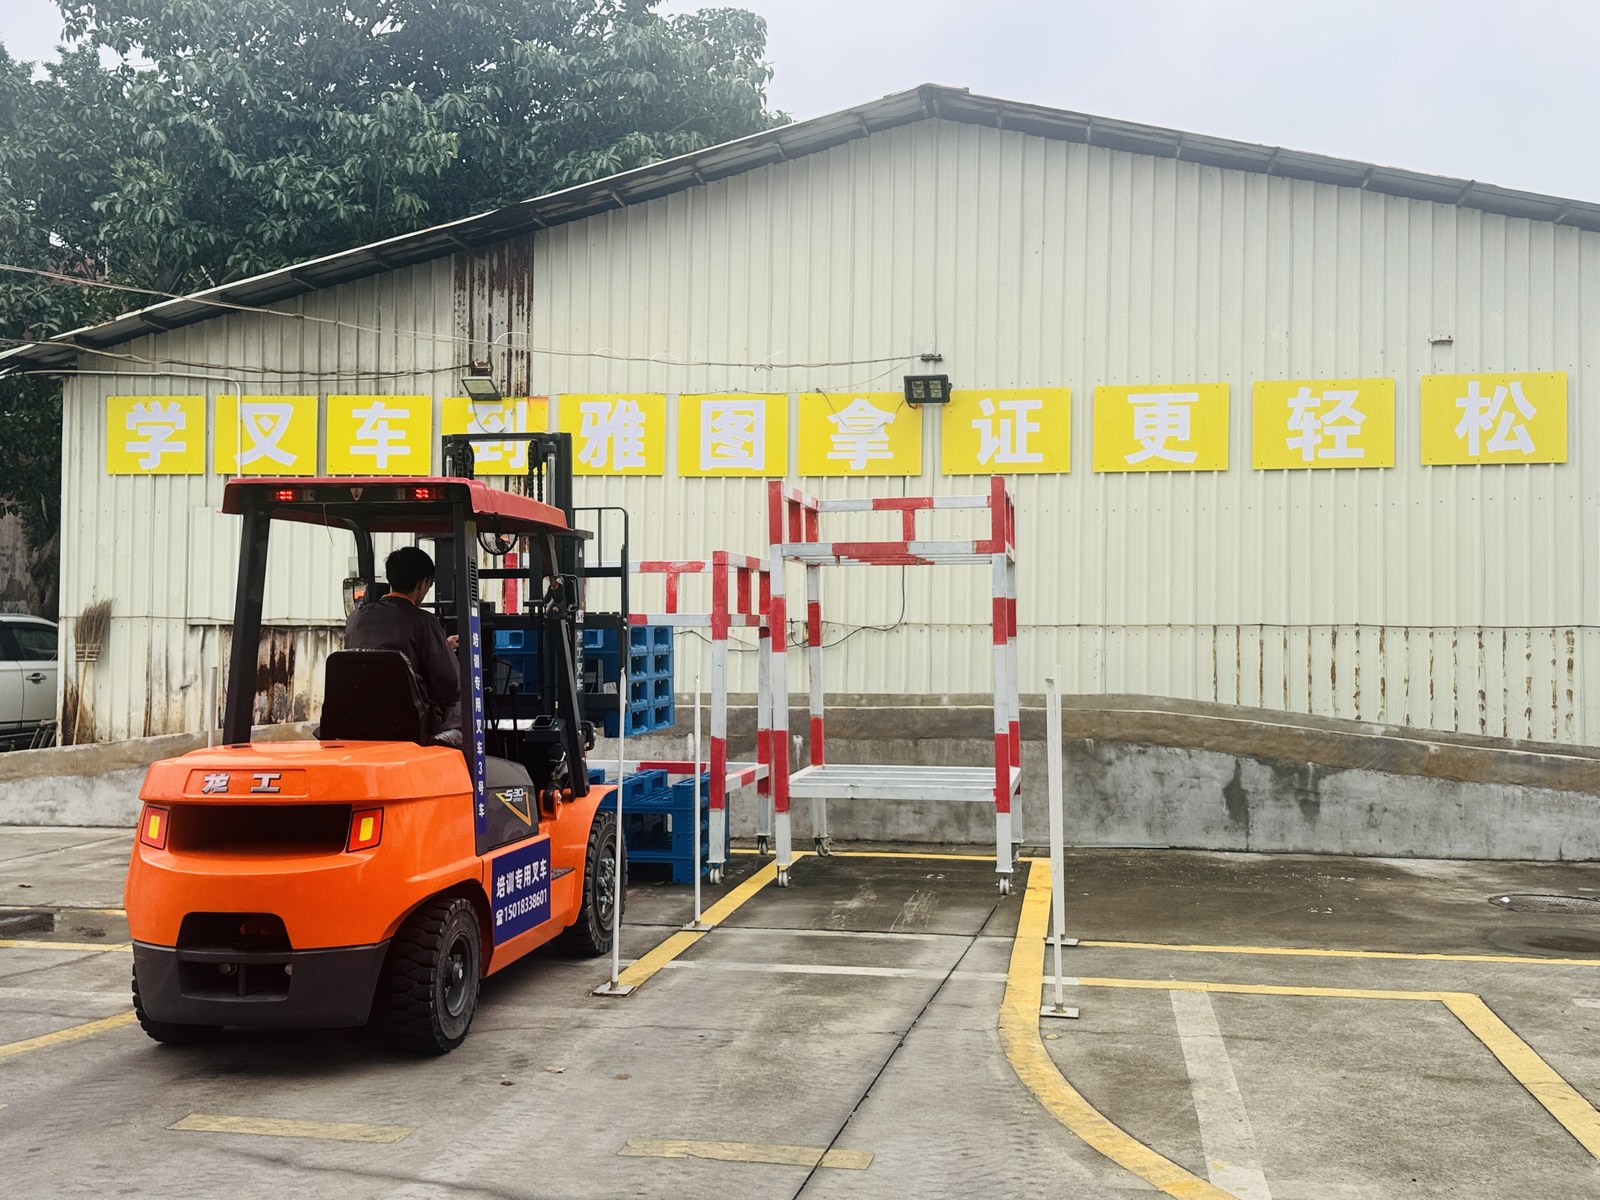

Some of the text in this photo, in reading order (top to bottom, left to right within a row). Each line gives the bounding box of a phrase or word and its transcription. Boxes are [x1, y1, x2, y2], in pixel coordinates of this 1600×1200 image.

[125, 381, 1537, 470] 学叉车到雅图拿证更轻松
[202, 772, 282, 793] 龙工
[496, 858, 547, 898] 培训专用叉车
[504, 888, 547, 922] 15018338601
